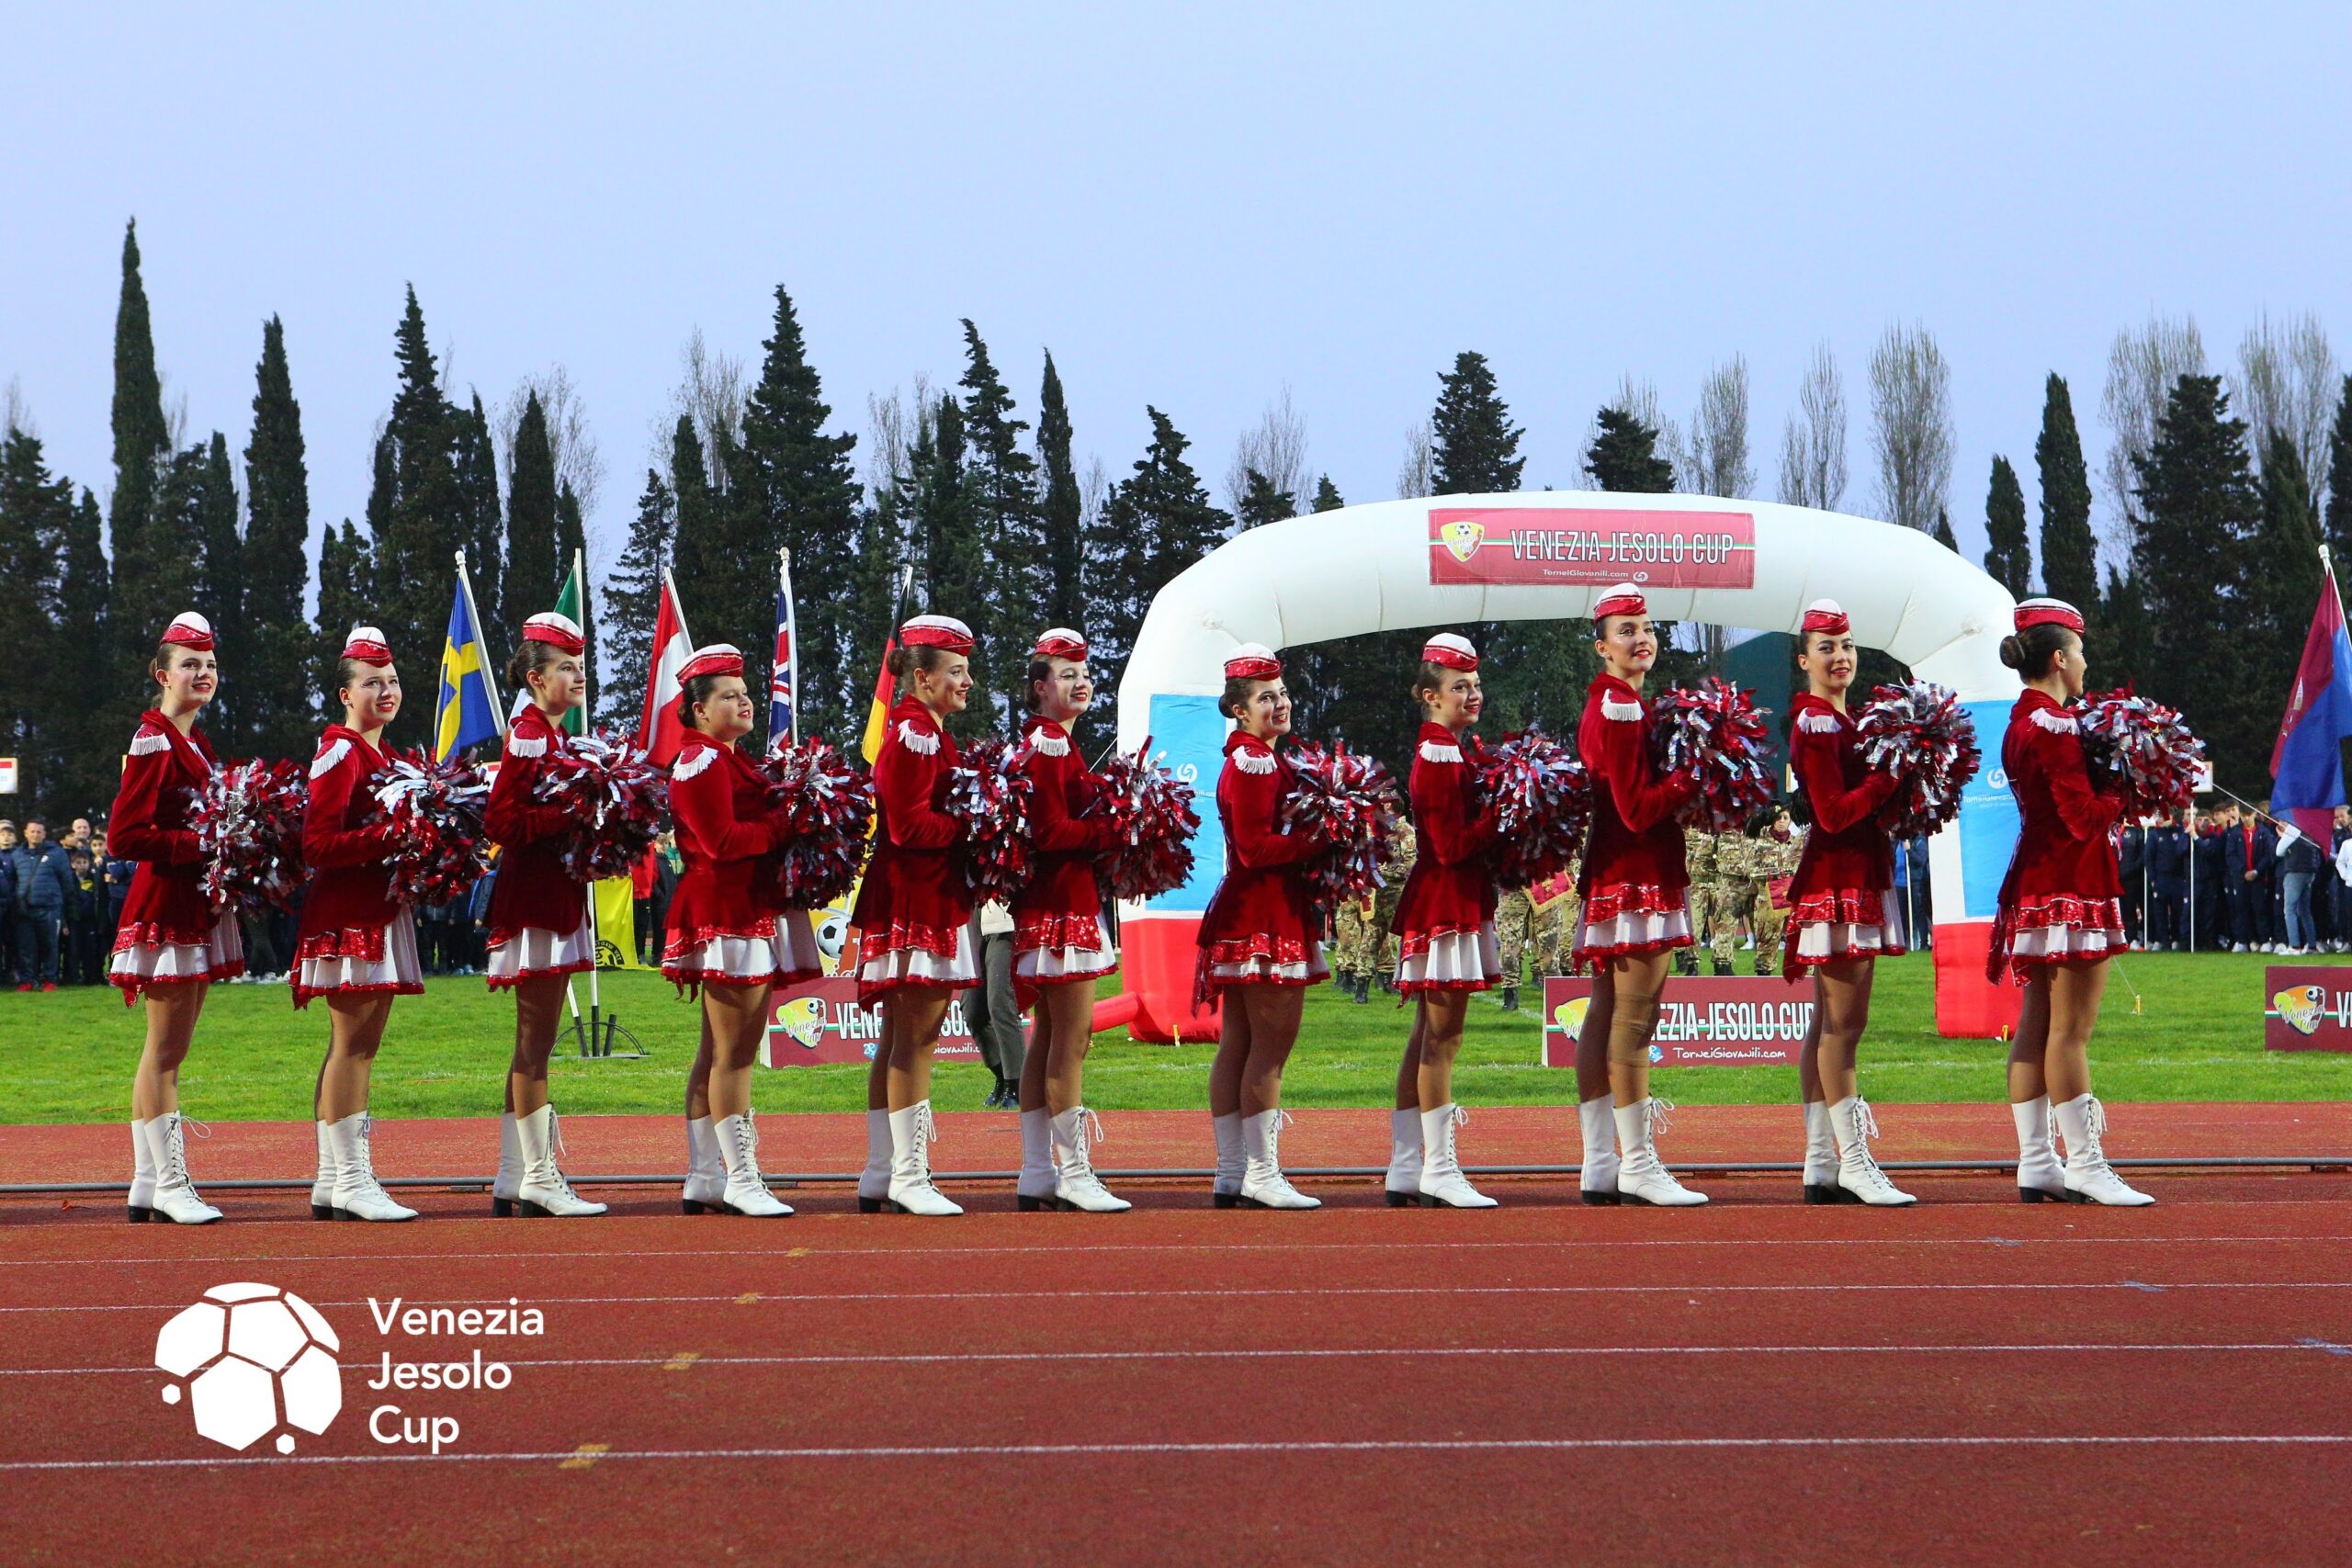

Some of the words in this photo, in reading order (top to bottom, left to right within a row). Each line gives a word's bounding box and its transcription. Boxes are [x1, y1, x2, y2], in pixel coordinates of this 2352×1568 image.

[1510, 529, 1601, 561] VENEZIA
[1608, 531, 1685, 564] JESOLO
[1691, 533, 1735, 565] CUP
[1543, 569, 1629, 578] TorneiGiovanili.com
[1651, 1002, 1774, 1041] EZIA-JESOLO
